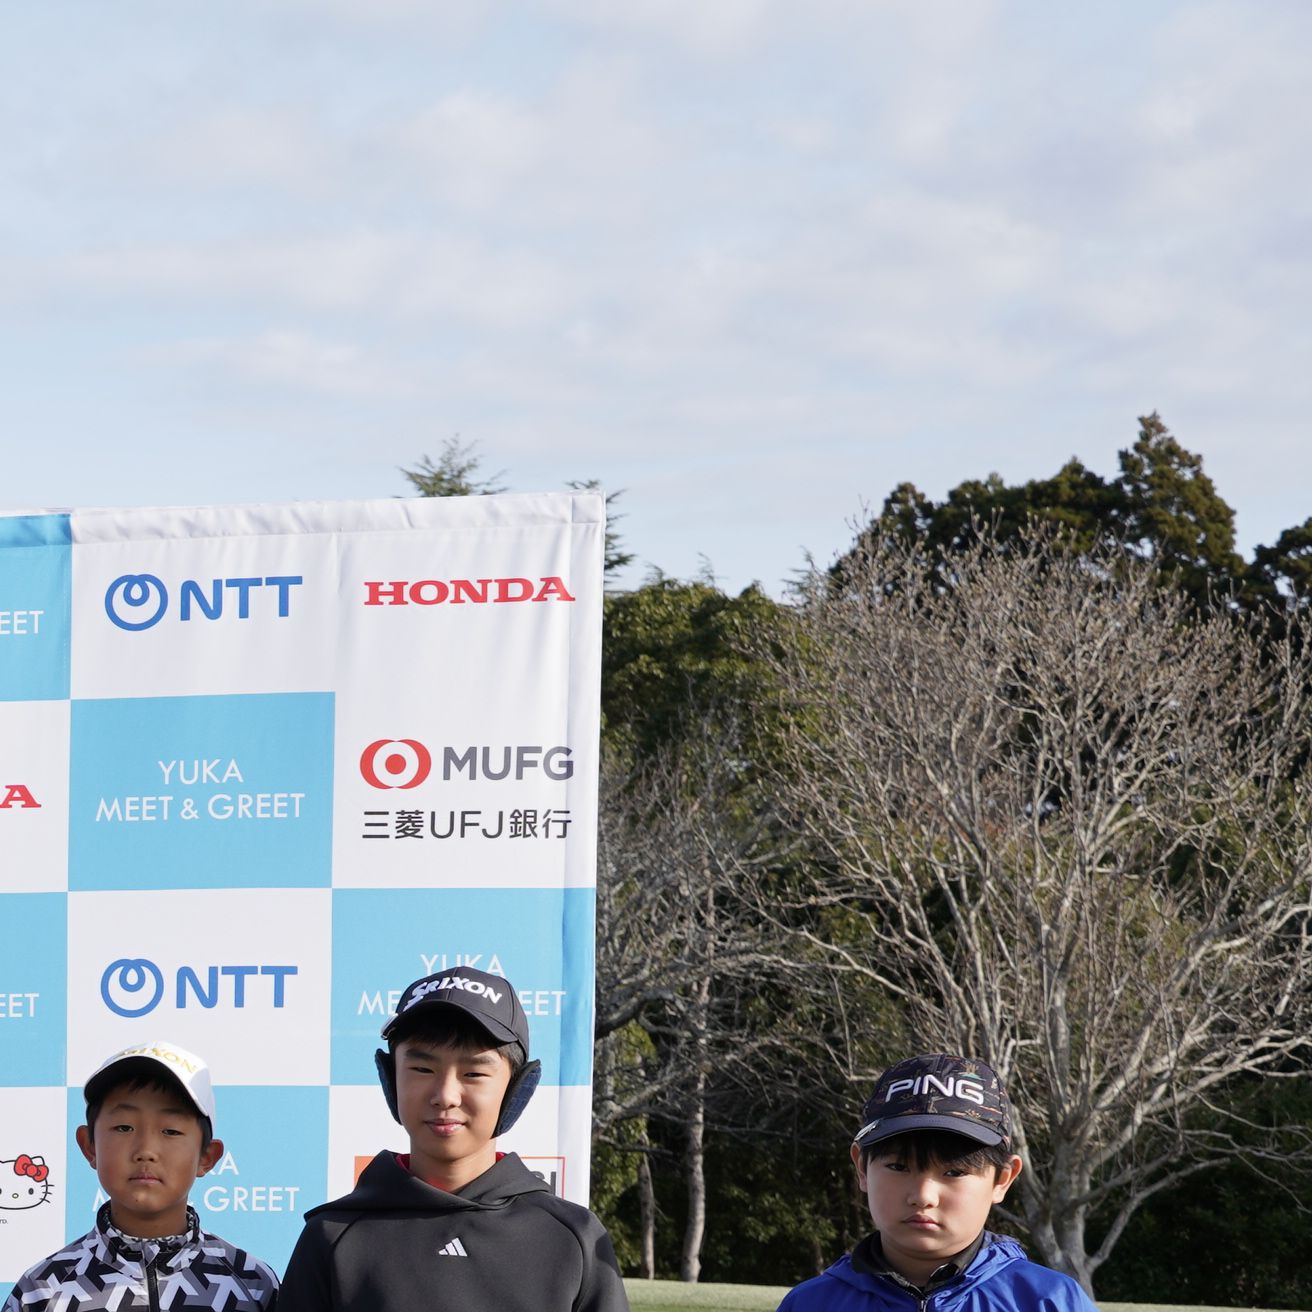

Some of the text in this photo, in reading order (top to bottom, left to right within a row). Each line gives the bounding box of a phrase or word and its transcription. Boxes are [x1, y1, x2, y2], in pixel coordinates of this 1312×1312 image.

[180, 576, 302, 621] NTT
[364, 577, 575, 605] HONDA
[159, 759, 243, 784] YUKA
[443, 746, 574, 781] MUFG
[96, 793, 305, 821] MEET & GREET
[362, 810, 573, 840] 三菱UFJ銀行
[176, 966, 298, 1008] NTT
[404, 977, 502, 1010] SRIXON
[885, 1074, 985, 1105] PING
[204, 1186, 299, 1212] GREET
